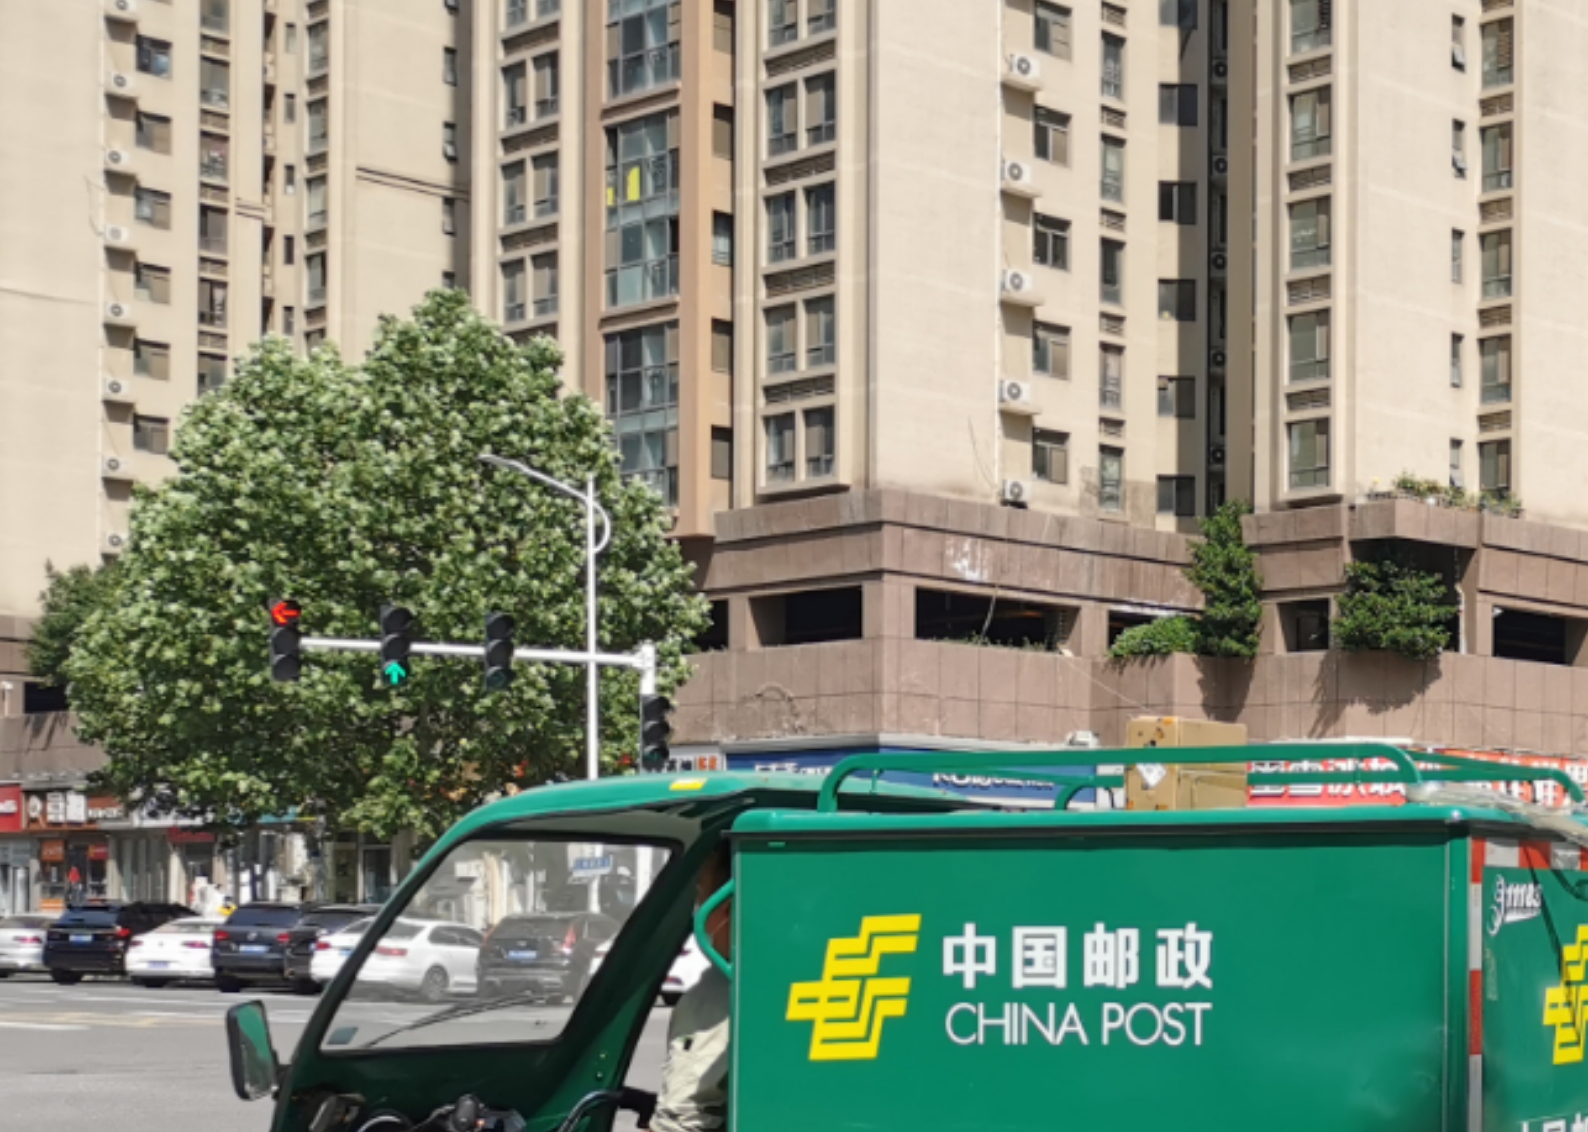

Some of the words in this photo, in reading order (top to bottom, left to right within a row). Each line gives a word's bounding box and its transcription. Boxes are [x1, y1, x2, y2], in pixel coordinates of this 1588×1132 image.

[943, 922, 1213, 989] 中国邮政
[945, 1002, 1089, 1046] CHINA
[1102, 1002, 1212, 1046] POST
